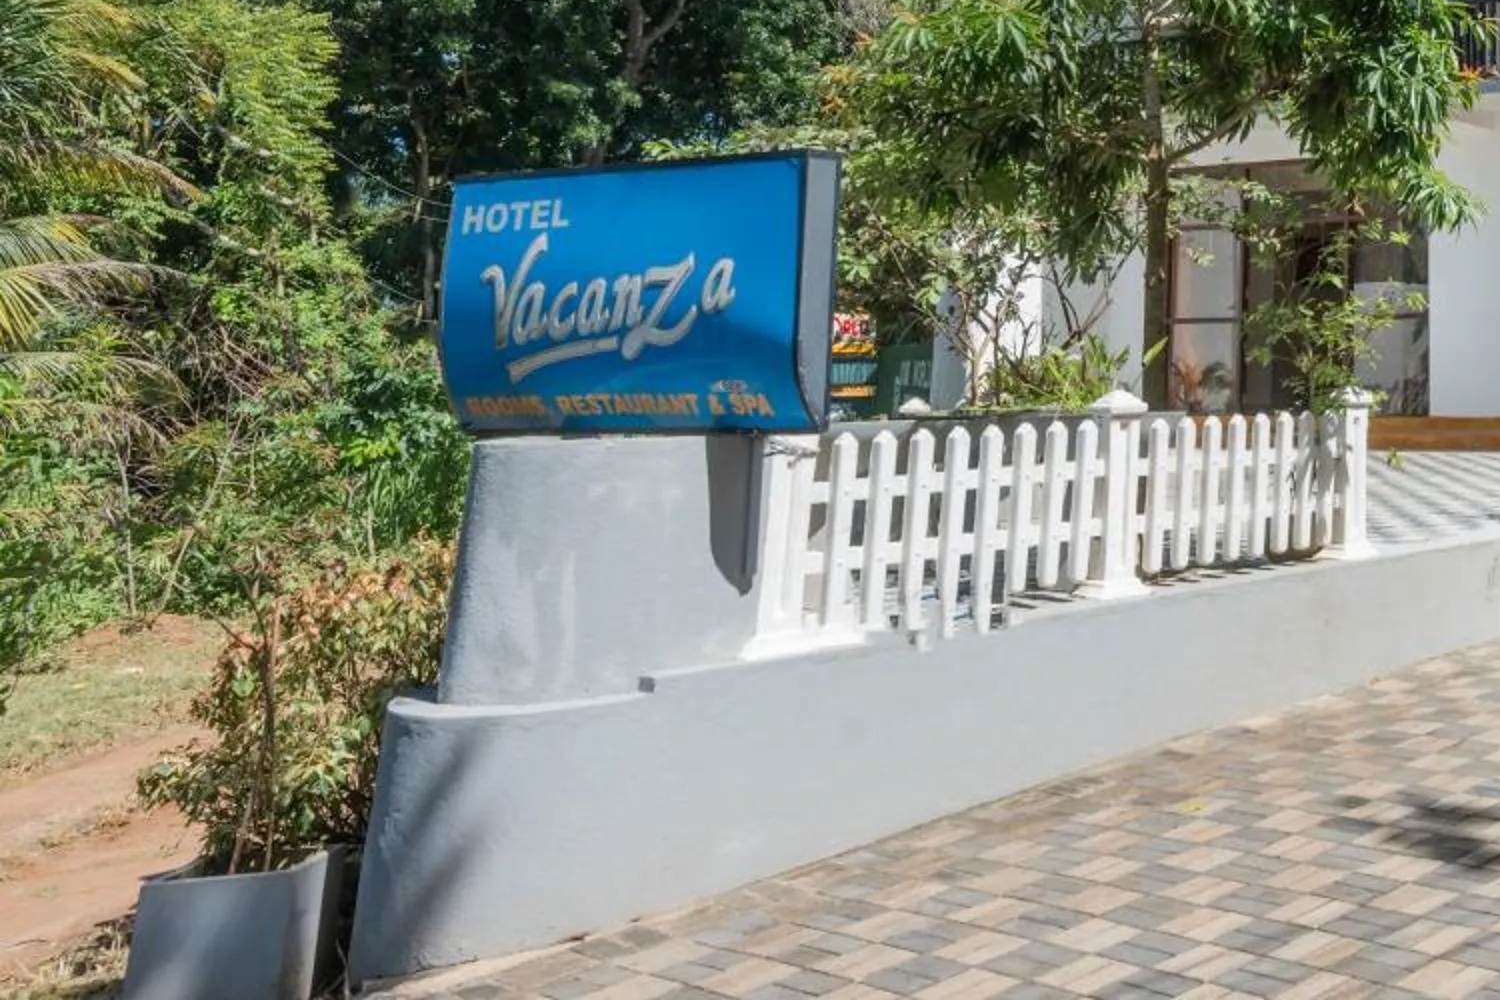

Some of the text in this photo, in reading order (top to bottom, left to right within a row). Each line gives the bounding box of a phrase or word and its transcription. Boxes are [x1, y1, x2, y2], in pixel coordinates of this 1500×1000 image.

[461, 199, 569, 235] HOTEL
[555, 392, 699, 417] RESTAURANT
[707, 393, 725, 416] &
[729, 391, 775, 418] SPA
